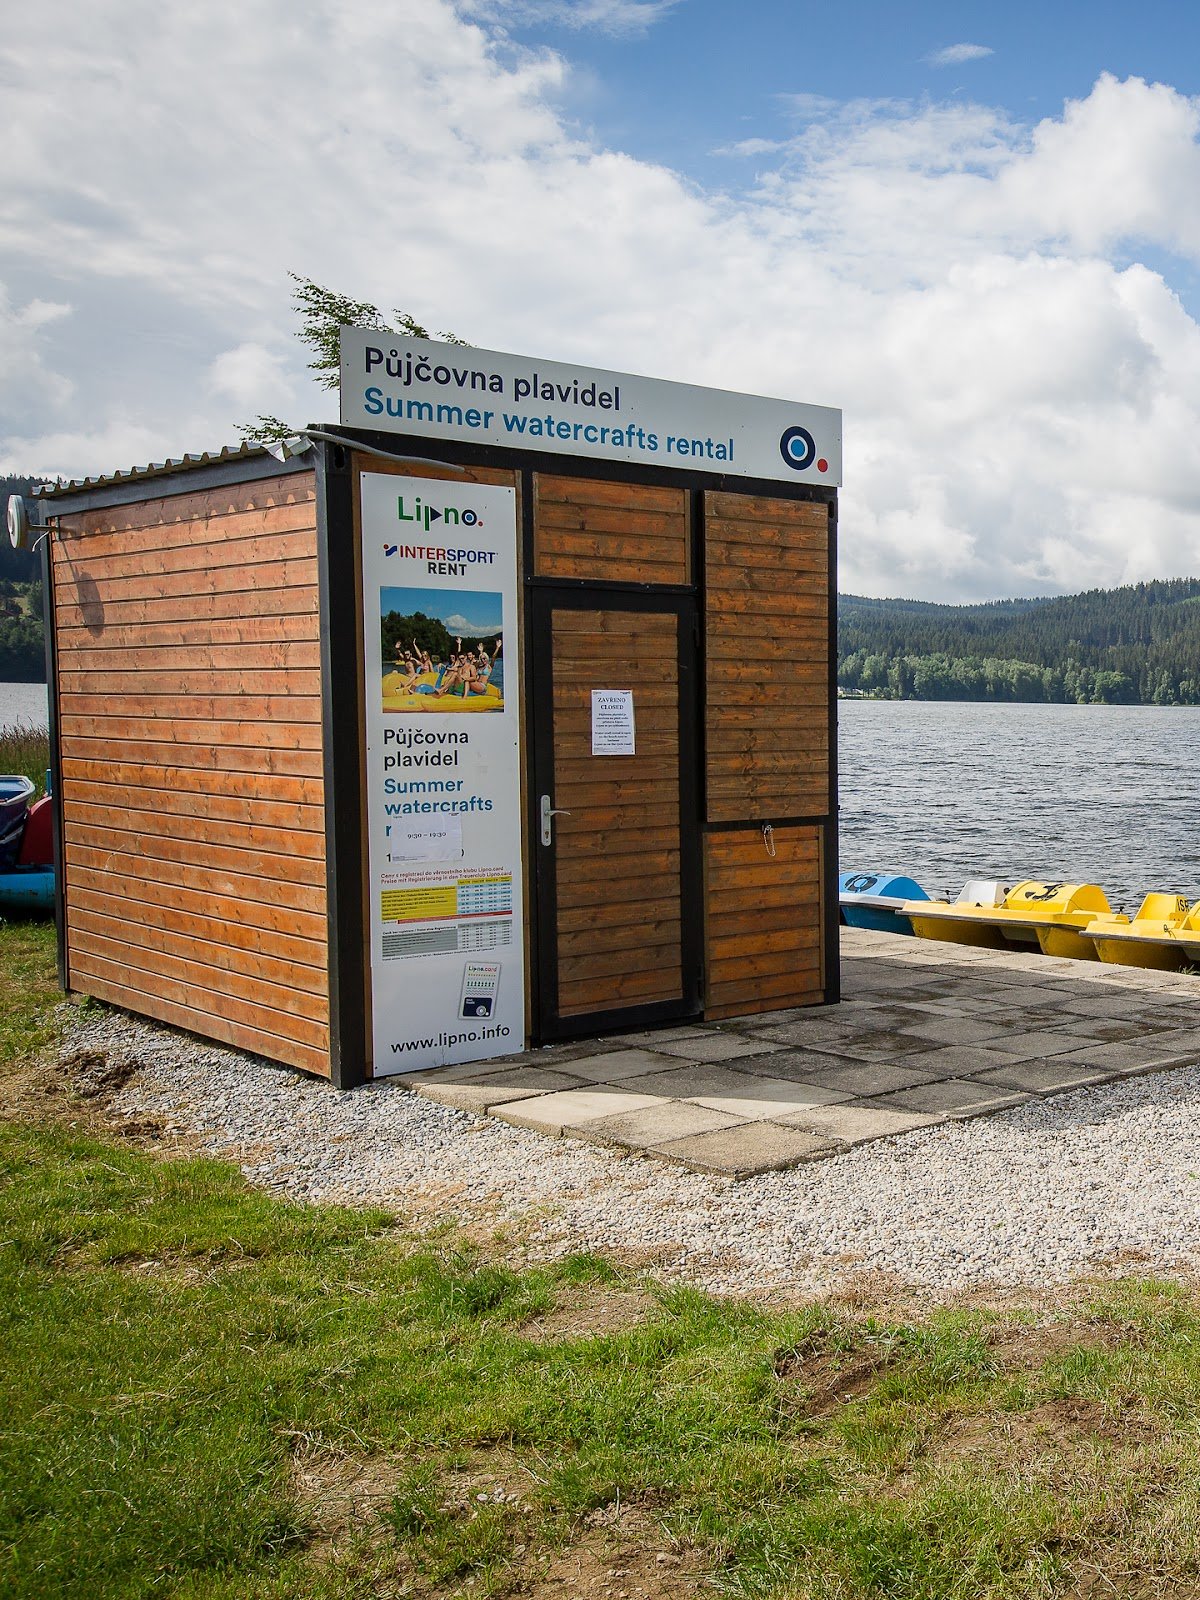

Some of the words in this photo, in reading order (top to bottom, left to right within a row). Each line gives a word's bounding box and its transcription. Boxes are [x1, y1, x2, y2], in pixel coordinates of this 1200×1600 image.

[364, 346, 504, 393] Půjčovna
[514, 372, 621, 411] plavidel
[364, 387, 494, 429] Summer
[502, 414, 660, 452] watercrafts
[666, 432, 734, 461] rental
[400, 545, 496, 563] INTERSPORT
[427, 562, 467, 576] RENT
[383, 728, 469, 748] Půjčovna
[384, 750, 458, 771] plavidel
[384, 778, 464, 794] Summer
[385, 796, 493, 815] watercrafts
[391, 1024, 511, 1053] www.lipno.info
